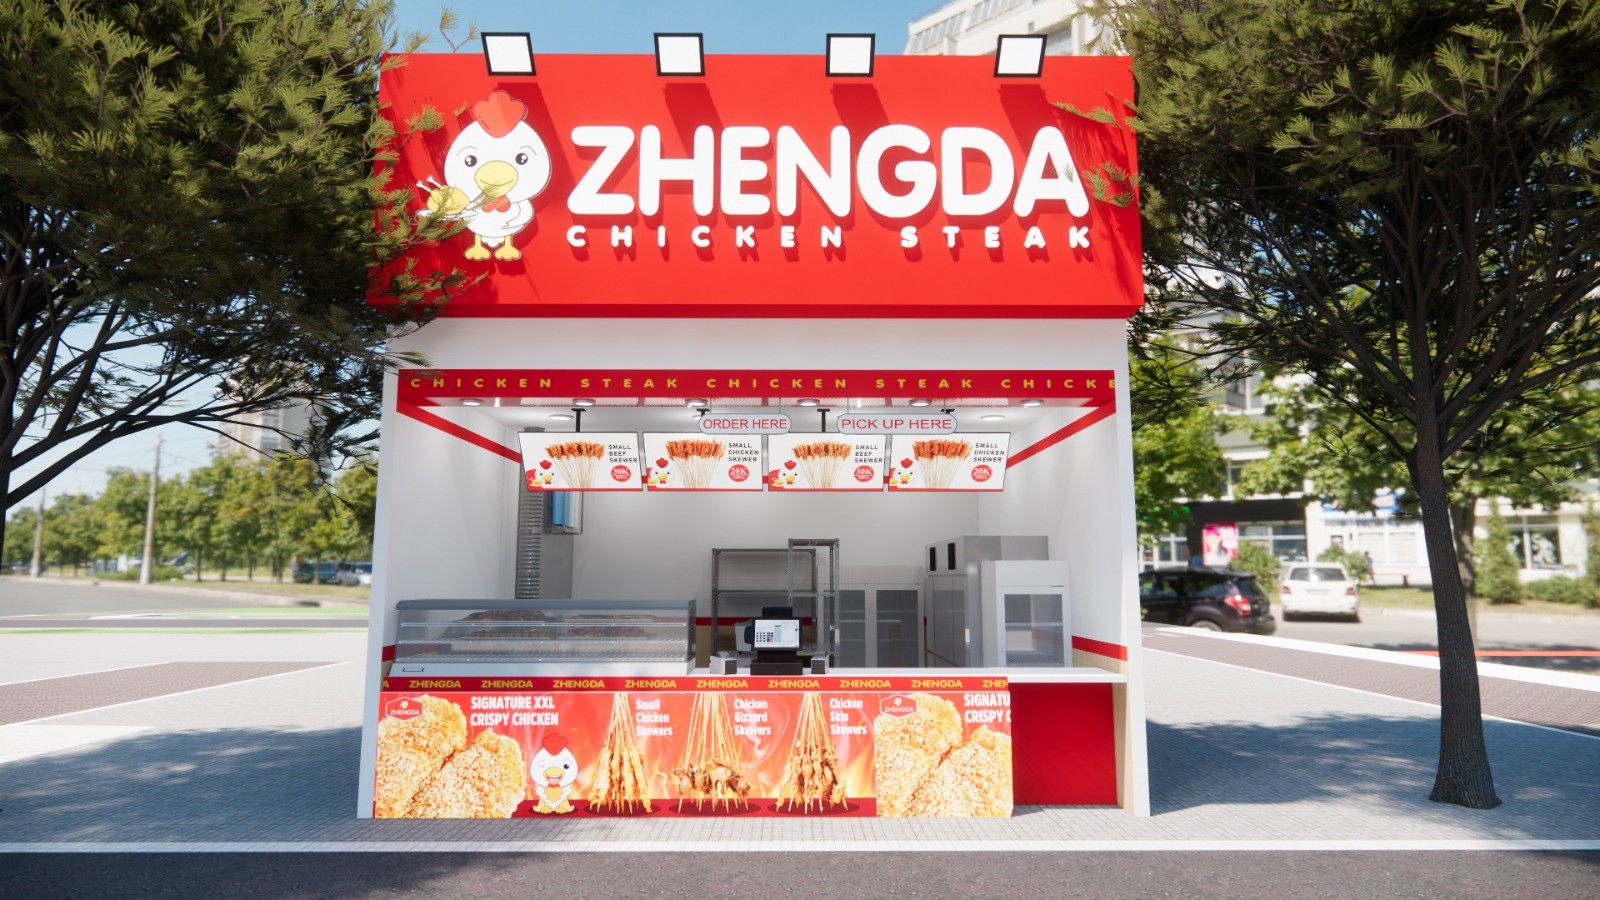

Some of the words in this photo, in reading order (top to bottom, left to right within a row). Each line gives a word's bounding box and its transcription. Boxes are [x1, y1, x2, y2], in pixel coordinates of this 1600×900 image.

[566, 124, 1090, 218] ZHENGDA
[566, 225, 842, 249] CHICKEN
[900, 225, 1090, 249] STEAK
[410, 378, 551, 389] CHICKEN
[580, 378, 678, 389] STEAK
[706, 378, 846, 389] CHICKEN
[875, 379, 972, 389] STEAK
[1000, 379, 1116, 389] CHICKE
[702, 418, 749, 430] ORDER
[751, 418, 787, 430] HERE
[841, 418, 878, 430] PICK
[882, 418, 904, 430] UP
[908, 418, 952, 430] HERE
[409, 680, 461, 688] ZHENGDA
[481, 680, 533, 688] ZHENGDA
[553, 680, 605, 688] ZHENGDA
[624, 680, 677, 688] ZHENGDA
[696, 679, 748, 688] ZHENGDA
[768, 679, 820, 688] ZHENGDA
[839, 679, 891, 688] ZHENGDA
[911, 679, 963, 688] ZHENGDA
[470, 696, 531, 710] SIGNATURE
[533, 696, 555, 710] XXL
[635, 699, 661, 710] Small
[733, 698, 768, 710] Chicken
[829, 697, 863, 709] Chicken
[963, 693, 1011, 707] SIGNATU
[470, 712, 510, 726] CRISPY
[511, 712, 559, 726] CHICKEN
[635, 712, 670, 723] Chicken
[734, 712, 768, 723] Gizzard
[829, 711, 849, 722] Skin
[964, 709, 1004, 723] CRISPY
[635, 725, 673, 736] Skewers
[734, 724, 772, 736] Skewers
[830, 724, 867, 735] Skewers
